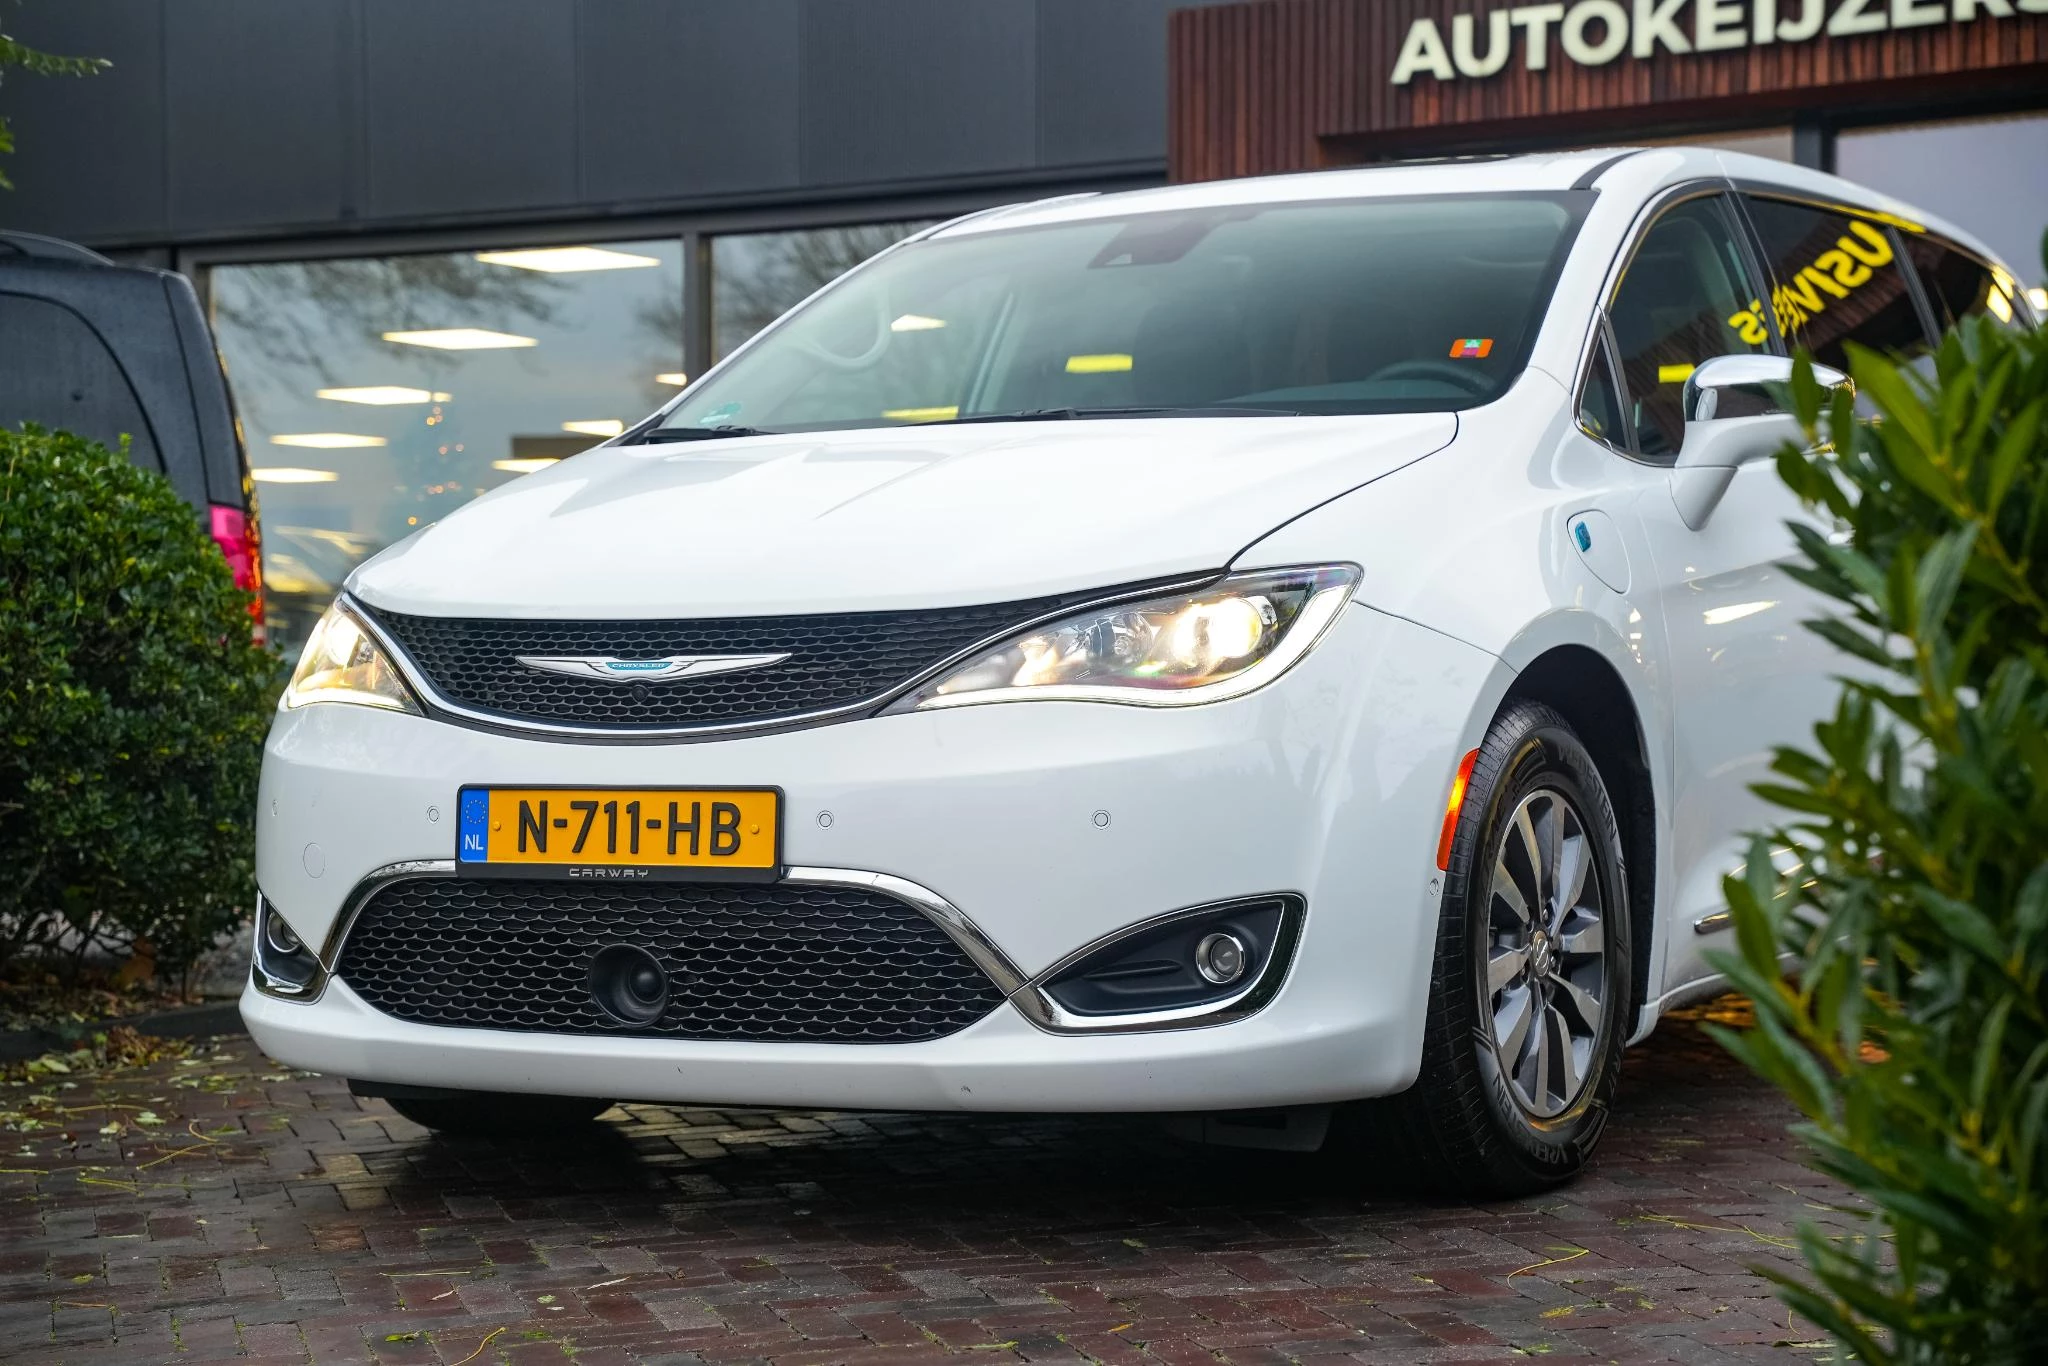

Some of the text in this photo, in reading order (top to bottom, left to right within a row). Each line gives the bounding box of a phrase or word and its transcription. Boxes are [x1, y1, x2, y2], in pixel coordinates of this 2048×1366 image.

[1390, 0, 2048, 84] AUTOKEIJZ
[464, 833, 484, 851] NL
[517, 799, 742, 856] N-711-HB
[568, 867, 650, 879] CARWAY
